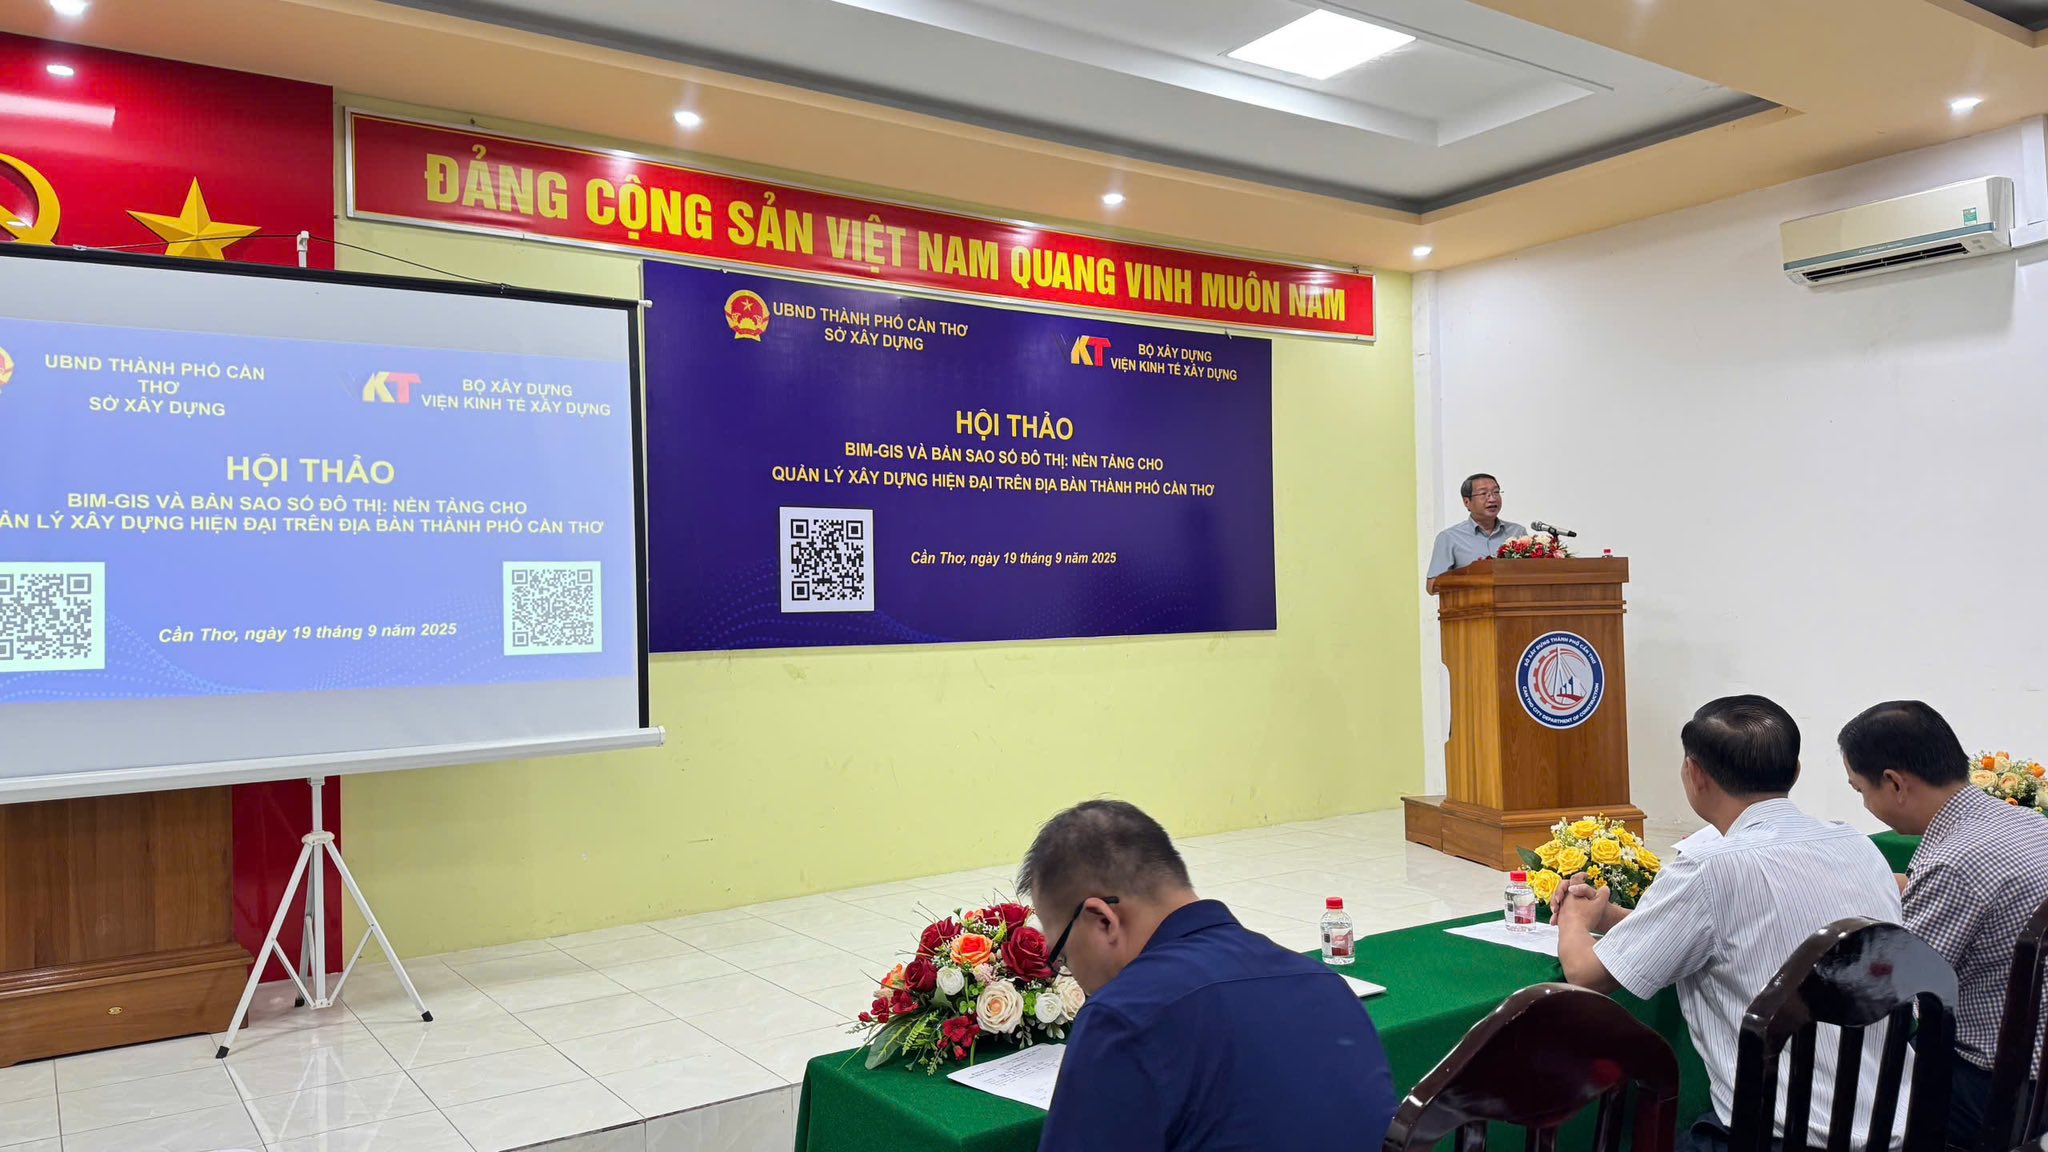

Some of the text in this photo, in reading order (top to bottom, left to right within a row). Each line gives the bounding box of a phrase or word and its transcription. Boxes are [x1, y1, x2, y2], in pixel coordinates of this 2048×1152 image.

[424, 144, 1346, 321] ĐẢNG CỘNG SẢN VIỆT NAM QUANG VINH MUÔN NAM
[773, 301, 816, 320] UBND
[820, 307, 870, 326] THÀNH
[939, 321, 969, 337] THƠ
[824, 326, 924, 351] SỞ XÂY DỰNG
[44, 353, 102, 371] UBND
[108, 355, 175, 376] THÀNH
[1138, 342, 1213, 362] BỘ XÂY DỰNG
[1110, 356, 1136, 373] VIỆN
[1139, 361, 1165, 374] KINH
[1183, 363, 1205, 377] XÂY
[1207, 366, 1238, 382] DỰNG
[137, 378, 180, 395] THƠ
[490, 377, 523, 394] XÂY
[526, 381, 573, 399] DỰNG
[88, 393, 225, 419] SỞ XÂY DỰNG
[464, 396, 501, 410] KINH
[530, 397, 562, 413] XÂY
[566, 400, 611, 417] DỰNG
[956, 408, 1074, 441] HỘI THẢO
[844, 442, 904, 459] BIM-GIS
[907, 443, 928, 460] VÀ
[931, 444, 962, 462] BẢN
[965, 449, 995, 463] SAO
[1021, 449, 1040, 466] ĐÔ
[1044, 452, 1068, 469] THỊ:
[1100, 452, 1135, 469] TẢNG
[1137, 457, 1164, 471] CHO
[226, 452, 395, 488] HỘI THẢO
[772, 463, 820, 483] QUẢN
[824, 465, 844, 484] LÝ
[848, 467, 880, 485] XÂY
[883, 471, 928, 489] DỰNG
[932, 472, 965, 491] HIỆN
[969, 475, 993, 492] ĐẠI
[995, 473, 1032, 491] TRÊN
[1035, 476, 1057, 494] ĐỊA
[1060, 475, 1087, 492] BÀN
[1089, 478, 1132, 494] THÀNH
[1190, 483, 1215, 497] THƠ
[67, 492, 150, 509] BIM-GIS
[155, 491, 185, 510] VÀ
[239, 495, 282, 512] SAO
[319, 494, 347, 512] ĐÔ
[353, 497, 387, 516] THỊ:
[489, 500, 527, 515] CHO
[36, 510, 65, 529] LÝ
[70, 511, 115, 530] XÂY
[121, 515, 184, 534] DỰNG
[242, 516, 276, 535] ĐẠI
[283, 516, 333, 532] TRÊN
[339, 518, 371, 535] ĐỊA
[376, 515, 415, 533] BÀN
[420, 516, 481, 533] THÀNH
[568, 520, 604, 534] THƠ
[910, 548, 1117, 567] Cần Thơ, ngày 19 tháng 9 năm 2025
[158, 622, 457, 644] Cần Thơ, ngày 19 tháng 9 năm 2025
[1541, 714, 1573, 724] DEPARTMENT
[1579, 682, 1600, 717] CONSTRUCTION
